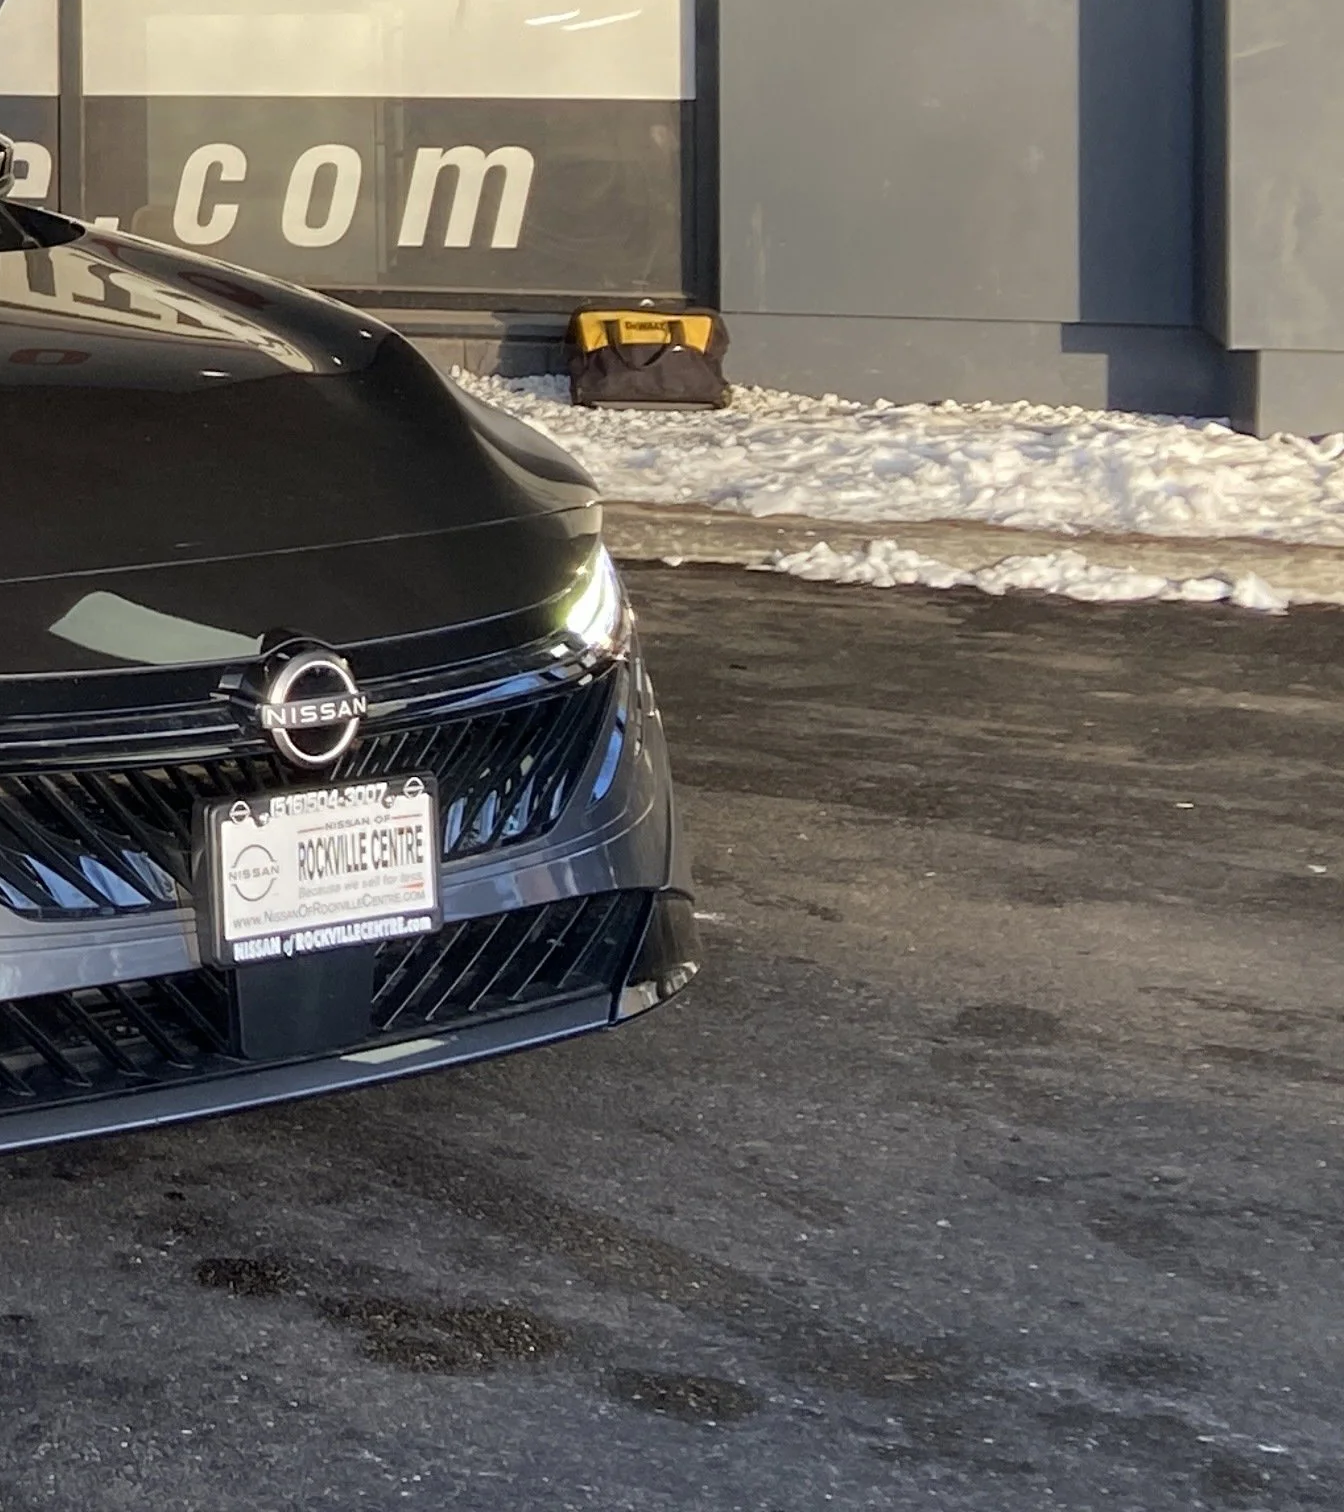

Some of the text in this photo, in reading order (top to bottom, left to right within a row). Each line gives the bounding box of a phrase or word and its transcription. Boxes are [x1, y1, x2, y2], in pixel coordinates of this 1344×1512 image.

[265, 696, 368, 727] NISSAN
[324, 814, 391, 832] NISSAN OF
[297, 824, 424, 882] ROCKVILLE CENTRE
[228, 865, 280, 882] NISSAN
[233, 935, 281, 962] NISSAN
[282, 934, 296, 957] of
